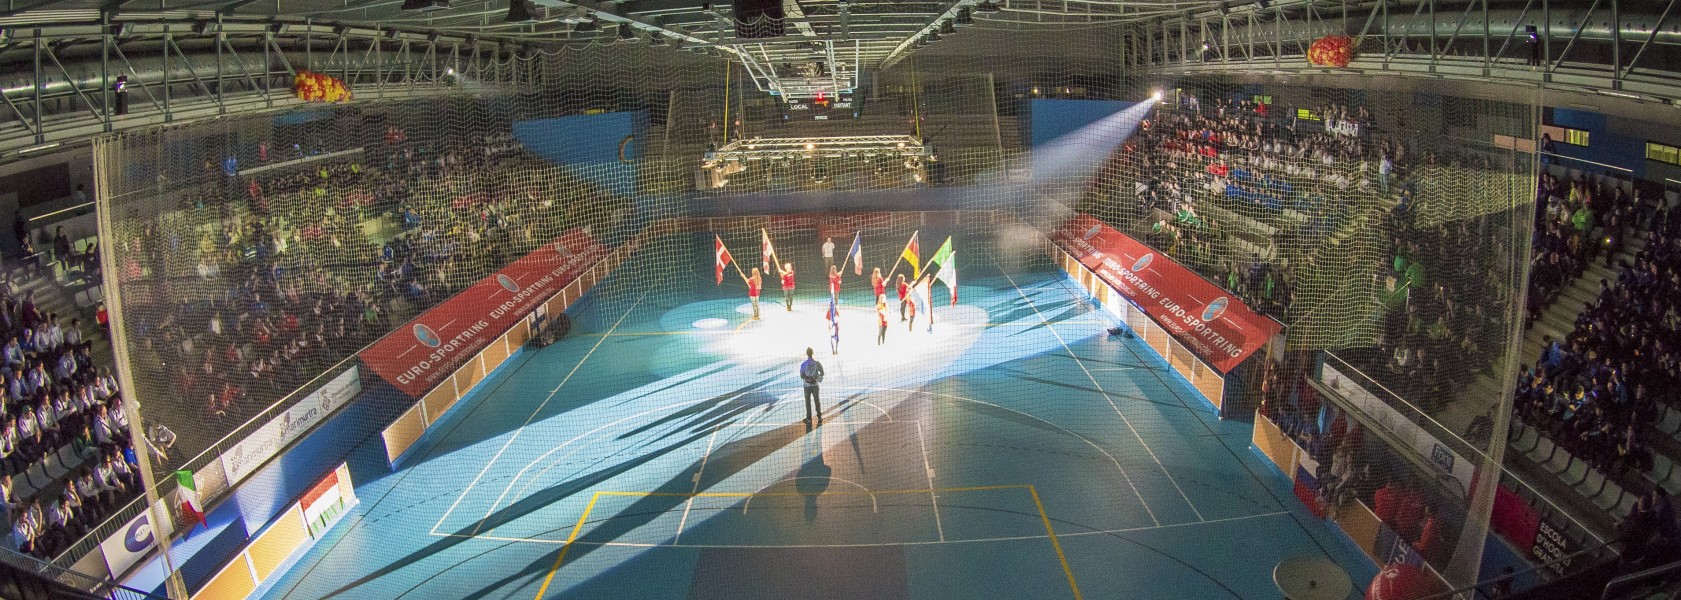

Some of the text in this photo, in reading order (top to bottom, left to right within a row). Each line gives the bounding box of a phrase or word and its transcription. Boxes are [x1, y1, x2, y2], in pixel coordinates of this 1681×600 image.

[397, 320, 489, 385] EURO-SPORTRING
[490, 275, 553, 320] EURO-SPORTRING
[1103, 258, 1160, 299] EURO-SPORTRING
[1159, 297, 1242, 358] EURO-SPORTRING
[1540, 522, 1566, 550] ESCOLA
